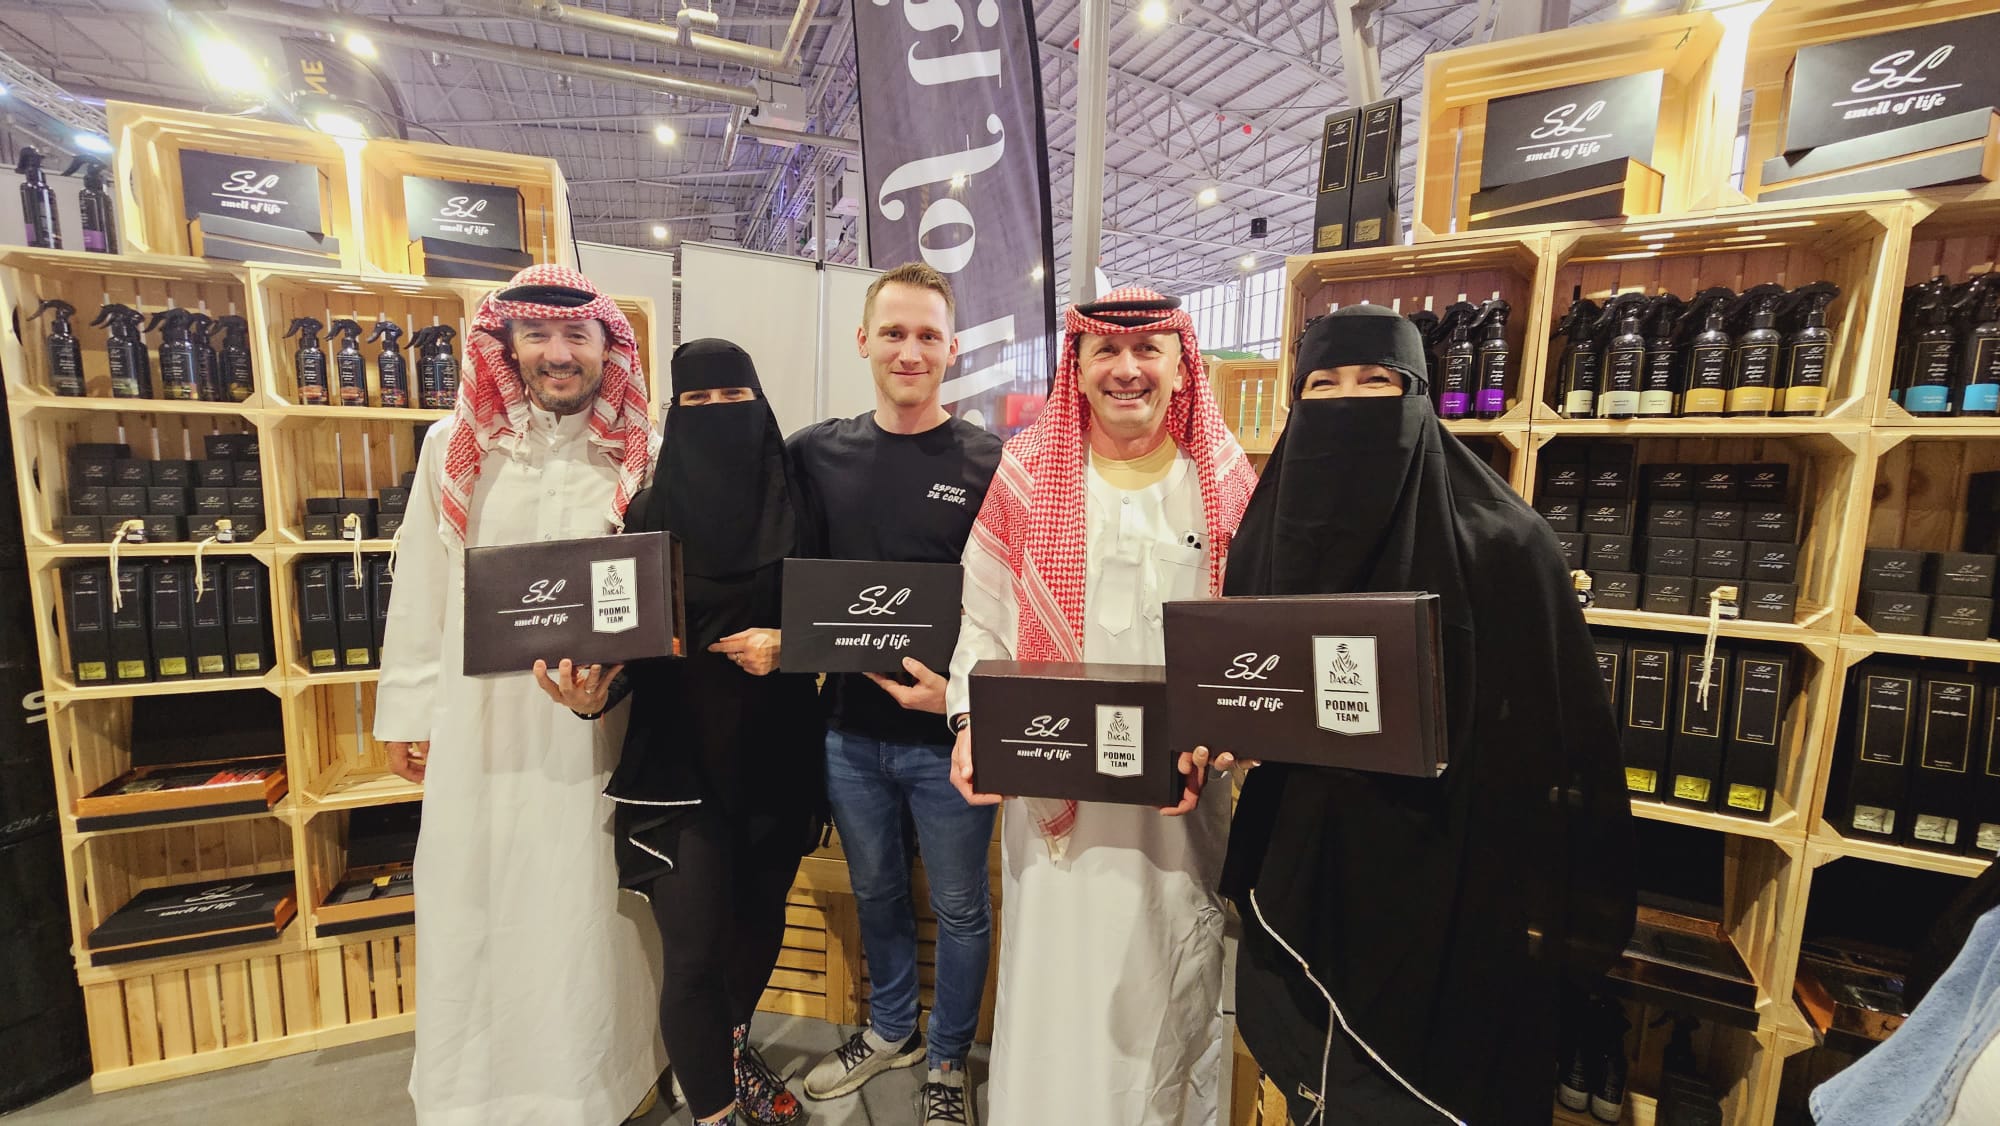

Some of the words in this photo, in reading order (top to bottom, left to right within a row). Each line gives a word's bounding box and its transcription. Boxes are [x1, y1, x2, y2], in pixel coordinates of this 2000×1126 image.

[1851, 44, 1955, 94] SL
[1843, 101, 1890, 120] smell
[1892, 97, 1915, 115] of
[1914, 93, 1947, 112] life
[1530, 100, 1607, 139] SL
[1525, 147, 1559, 163] smell
[1562, 144, 1578, 160] of
[1577, 141, 1602, 157] life
[221, 170, 280, 196] SL
[220, 199, 249, 211] smell
[250, 203, 264, 214] of
[263, 204, 282, 215] life
[440, 196, 488, 218] SL
[474, 225, 490, 237] life
[926, 490, 940, 499] DE
[942, 493, 967, 506] CORP.
[932, 483, 967, 497] ESPRIT
[521, 578, 567, 604] SL
[847, 585, 912, 616] SL
[599, 605, 631, 616] PODMOL
[514, 614, 539, 627] smell
[540, 613, 554, 626] of
[552, 612, 569, 626] life
[607, 615, 624, 624] TEAM
[834, 633, 871, 647] smell
[872, 633, 889, 650] of
[888, 634, 911, 650] life
[1224, 652, 1281, 681] SL
[1329, 670, 1363, 686] DAKAR
[1216, 695, 1247, 707] smell
[1249, 697, 1264, 711] of
[1263, 697, 1285, 712] life
[1325, 699, 1370, 713] PODMOL
[1335, 712, 1360, 723] TEAM
[1024, 715, 1071, 738] SL
[1107, 730, 1132, 742] DAKAR
[1016, 748, 1042, 758] smell
[1043, 749, 1056, 761] of
[1055, 749, 1072, 762] life
[1103, 751, 1136, 762] PODMOL
[1110, 761, 1128, 769] TEAM
